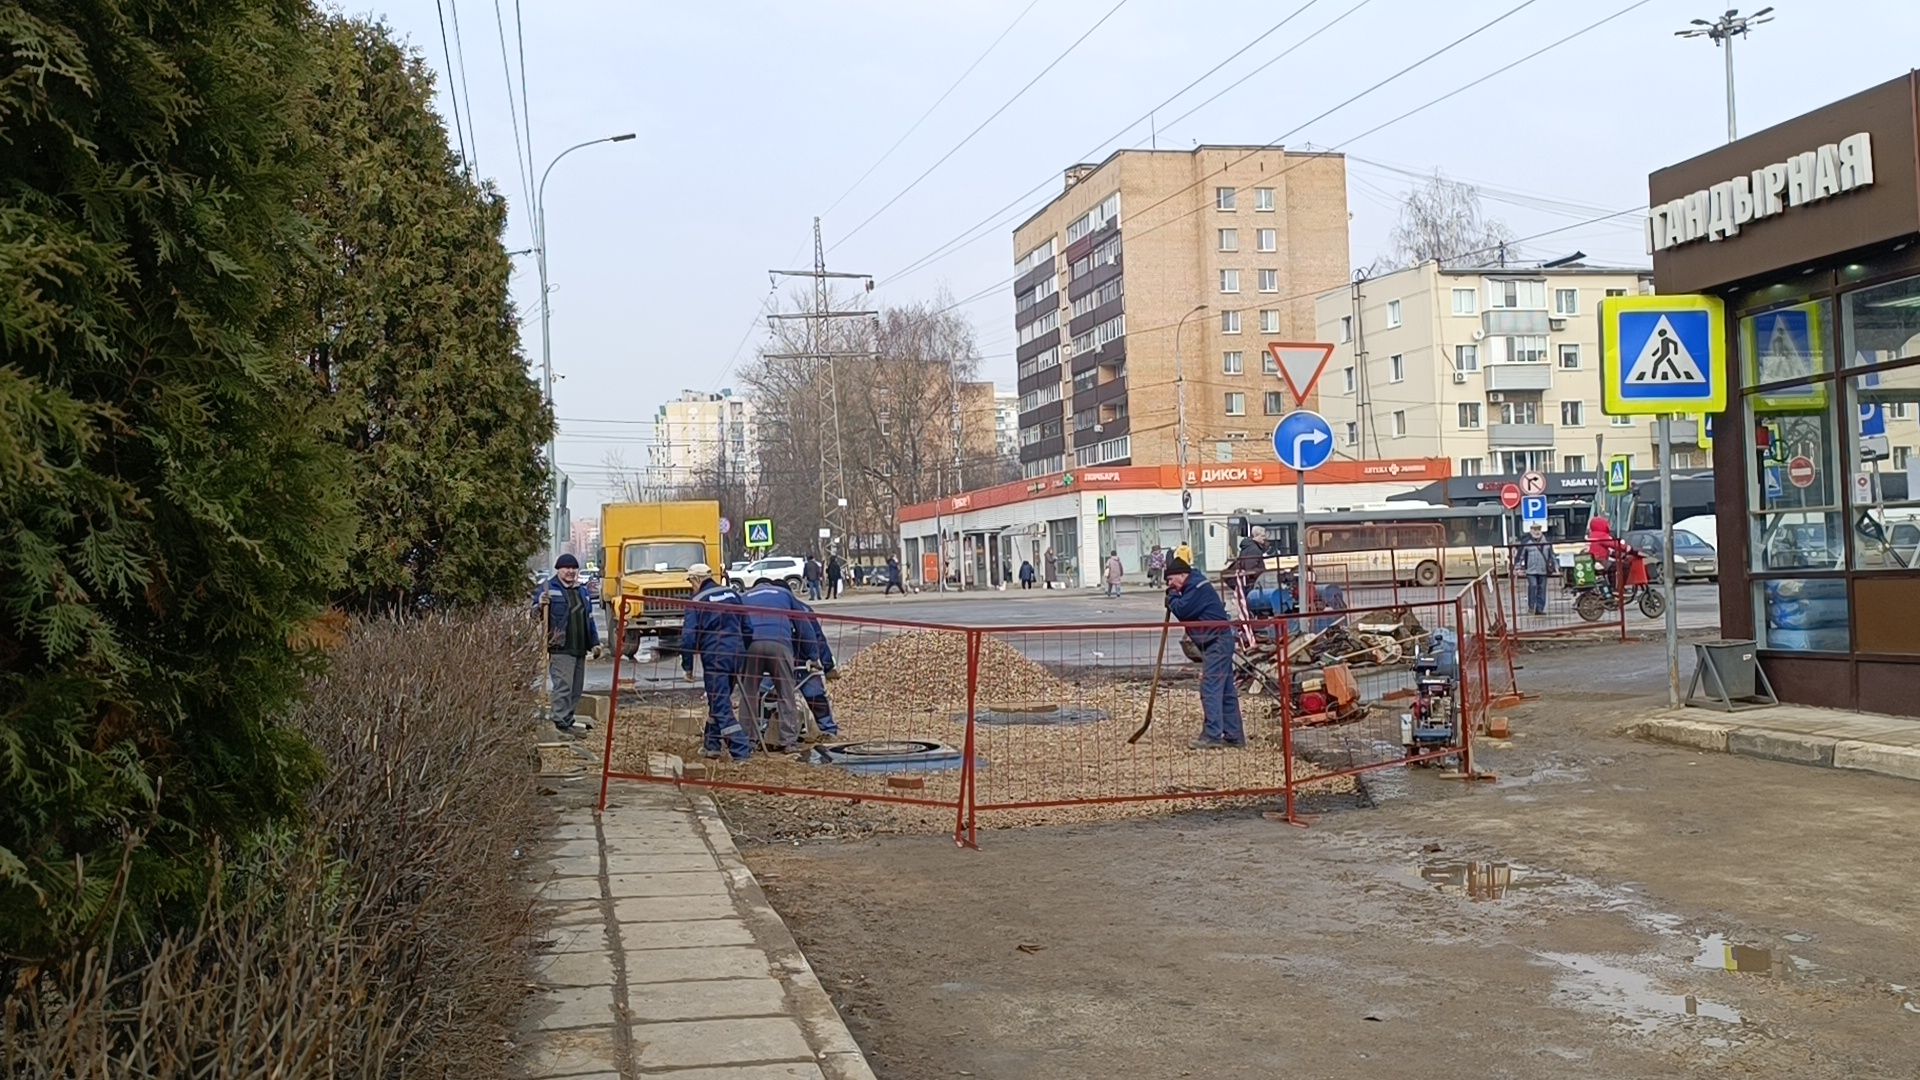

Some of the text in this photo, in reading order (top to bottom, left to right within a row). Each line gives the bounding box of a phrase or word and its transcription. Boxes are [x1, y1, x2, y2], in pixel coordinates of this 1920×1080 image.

[1647, 132, 1873, 252] ТАНДЫРНАЯ
[1201, 468, 1247, 482] ДИКСИ
[1527, 499, 1542, 518] P
